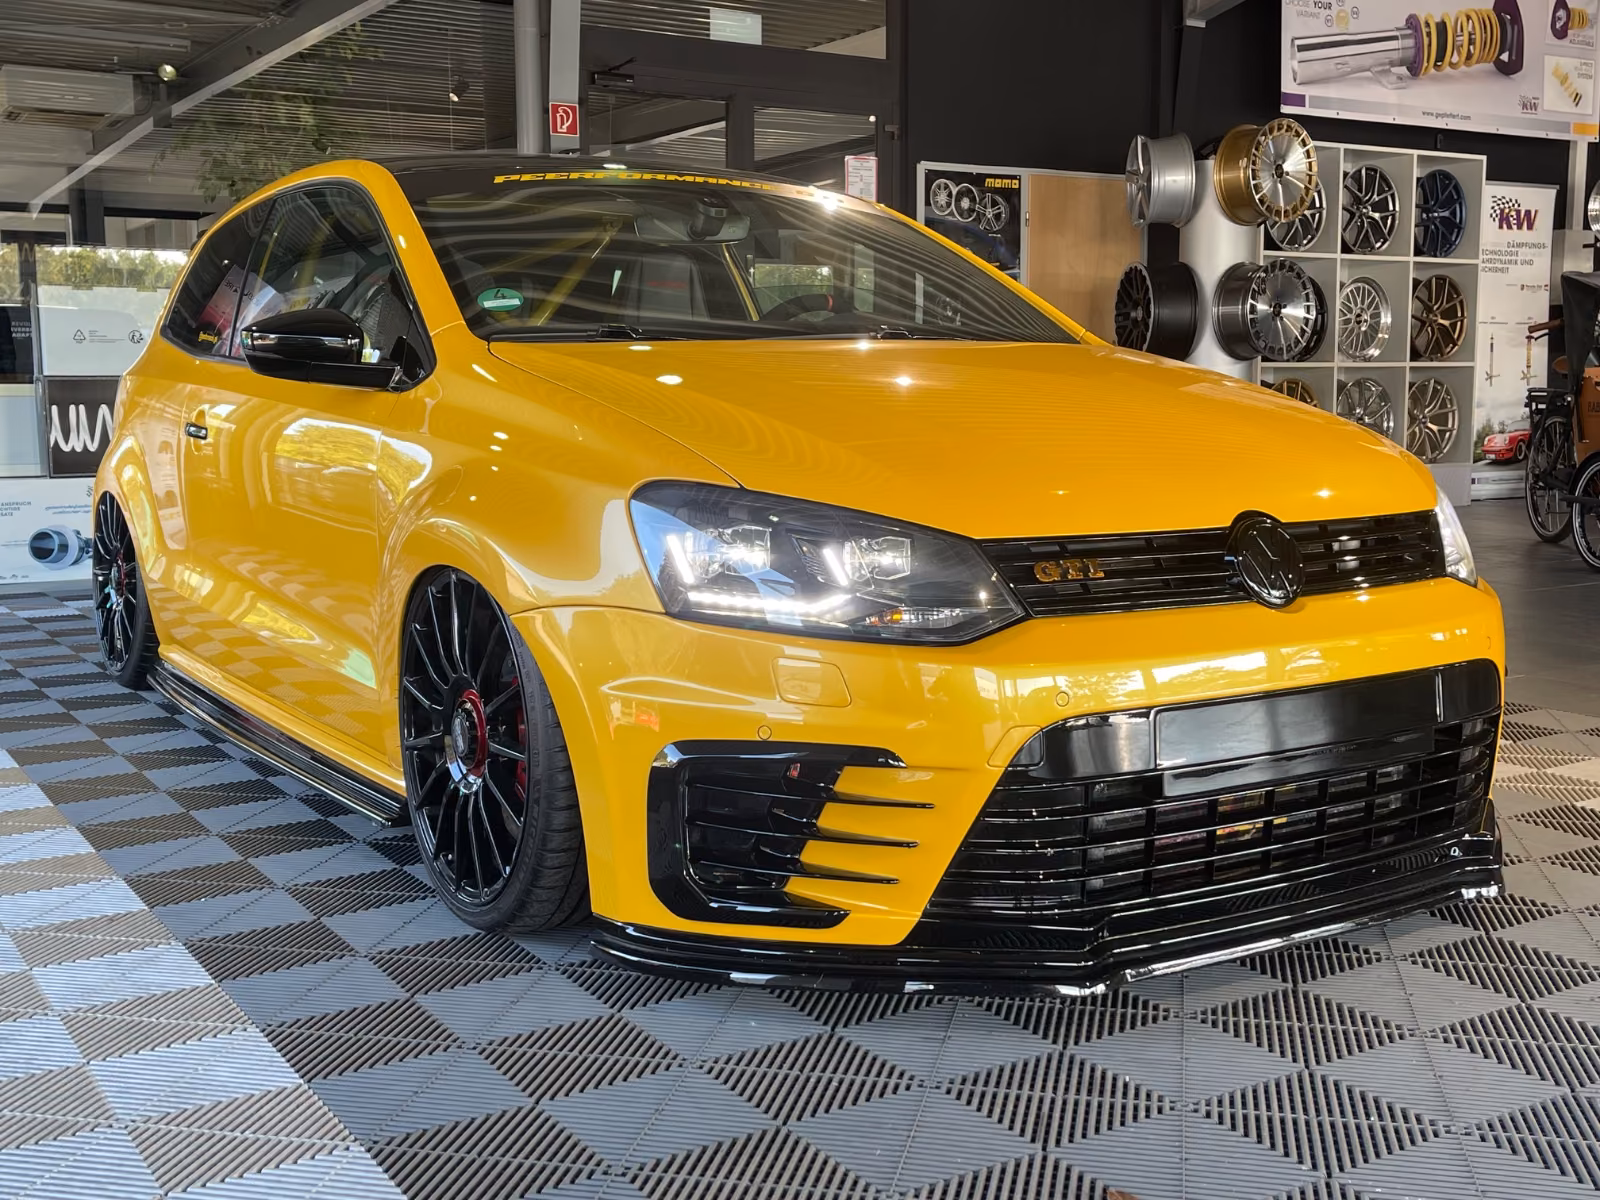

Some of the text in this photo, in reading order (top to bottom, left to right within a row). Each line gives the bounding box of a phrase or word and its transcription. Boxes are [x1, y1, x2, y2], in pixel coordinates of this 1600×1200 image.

[1313, 0, 1332, 10] YOUR
[1498, 208, 1539, 231] KW
[1034, 559, 1105, 582] GTI
